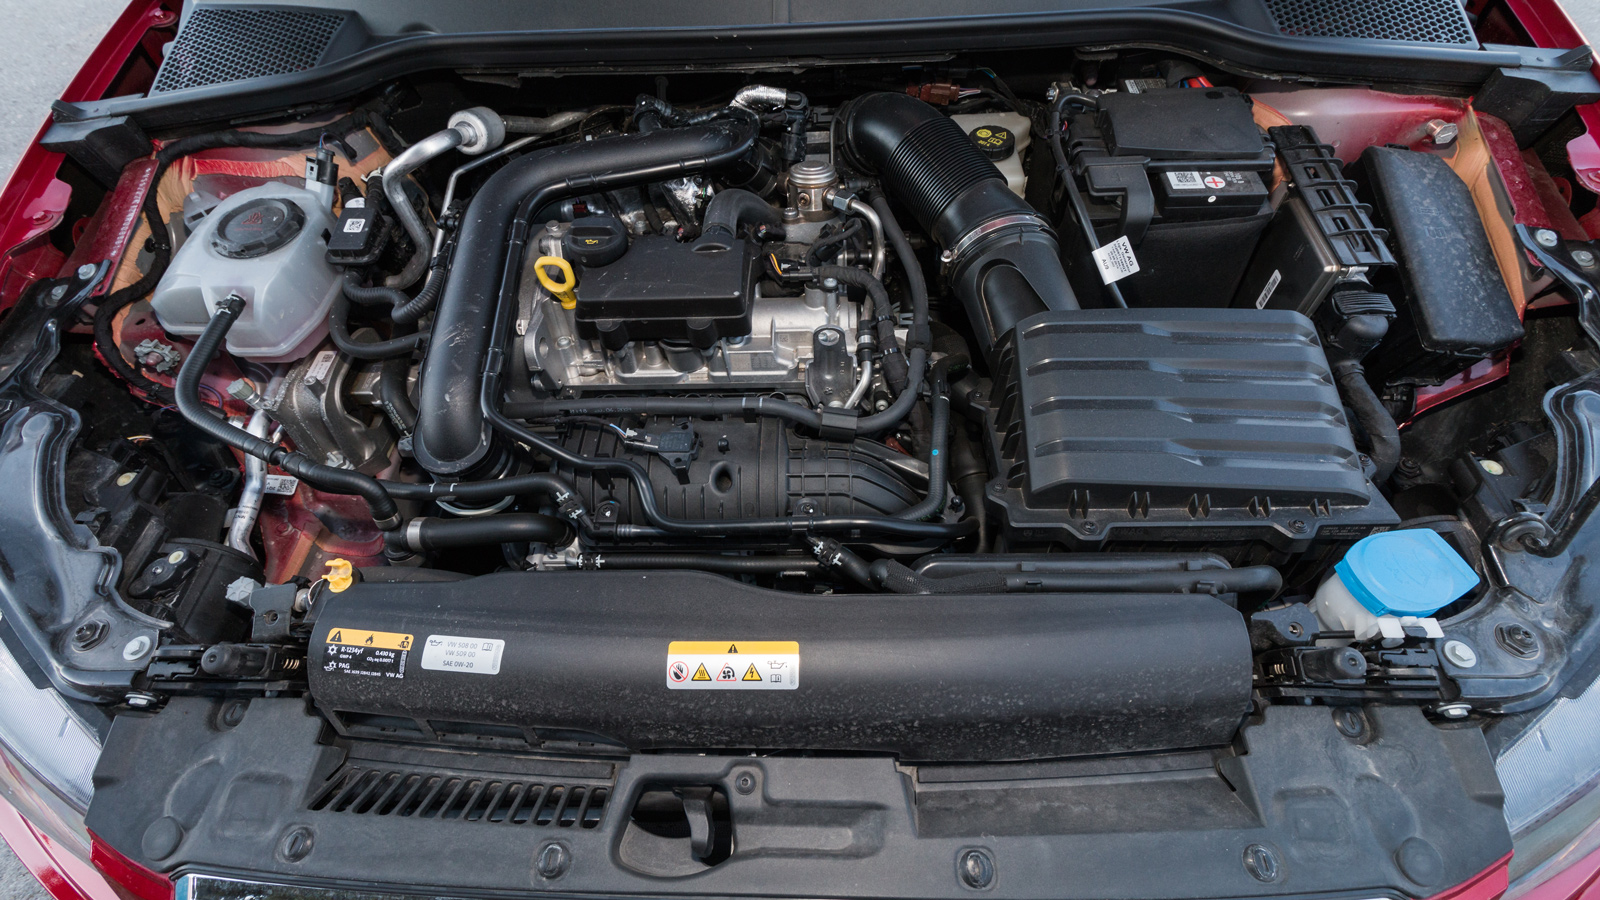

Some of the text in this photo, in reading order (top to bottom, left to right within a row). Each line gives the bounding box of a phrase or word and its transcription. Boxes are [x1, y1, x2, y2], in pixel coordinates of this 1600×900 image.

[1122, 242, 1134, 266] VW AG
[341, 647, 364, 655] R-1234yf
